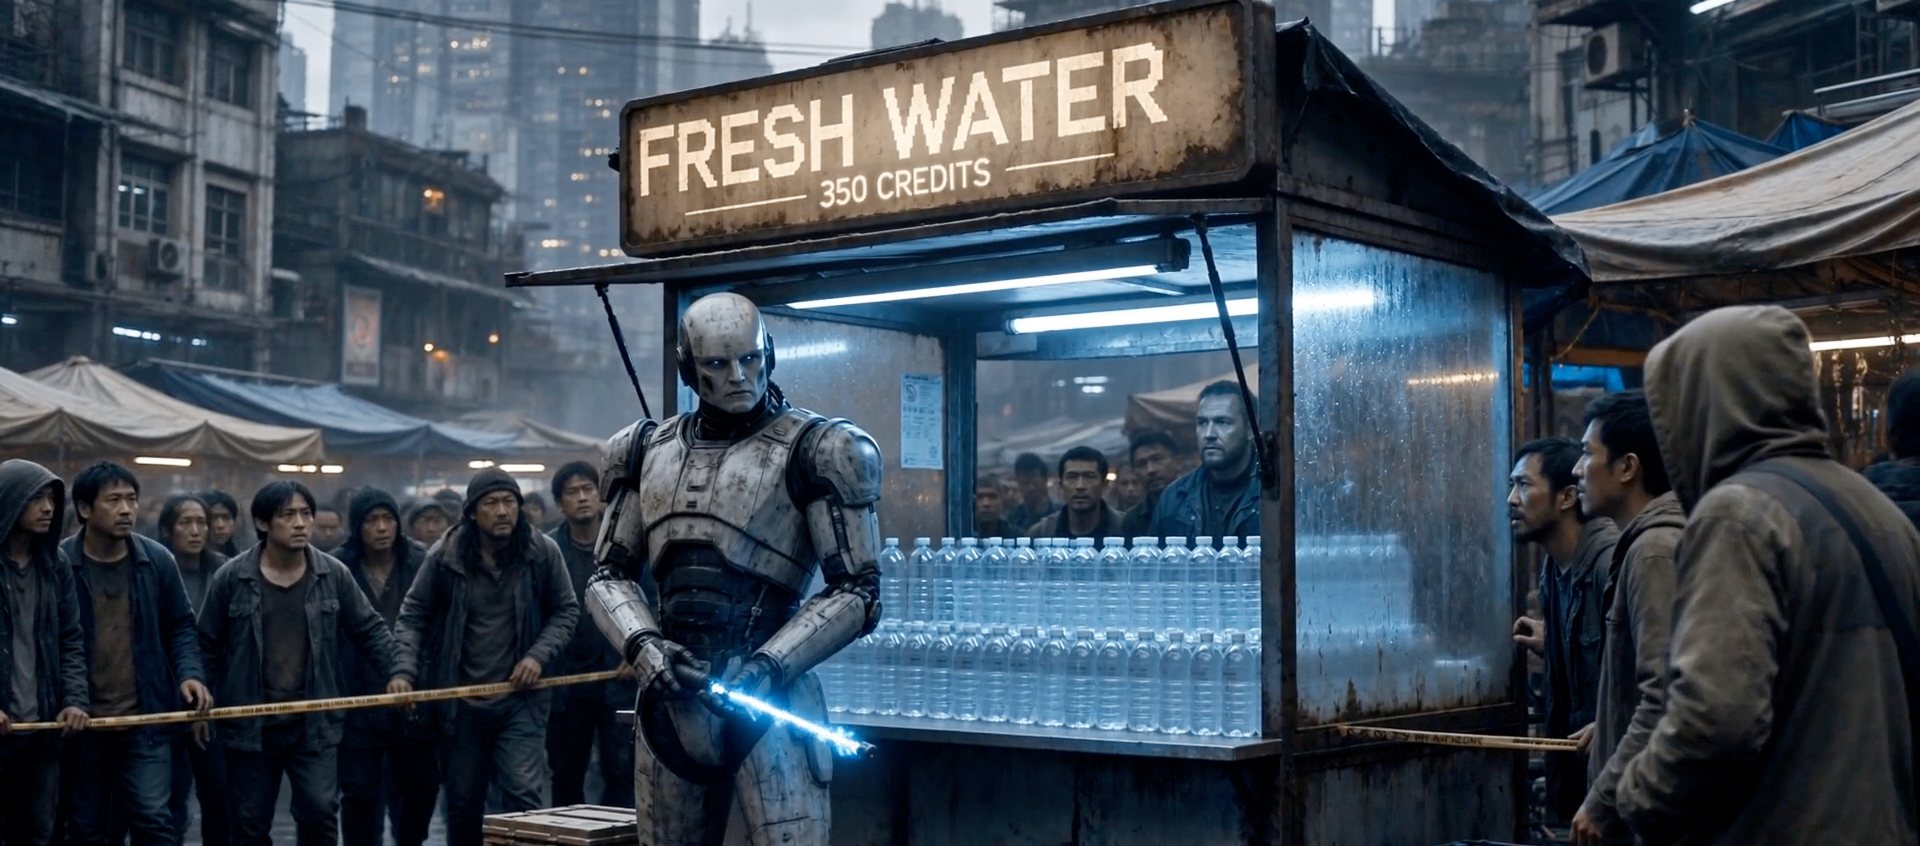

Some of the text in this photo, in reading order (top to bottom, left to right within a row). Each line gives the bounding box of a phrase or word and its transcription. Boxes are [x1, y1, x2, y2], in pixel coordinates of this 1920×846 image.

[640, 41, 1168, 197] FRESH WATER
[820, 157, 991, 209] 350 CREDITS
